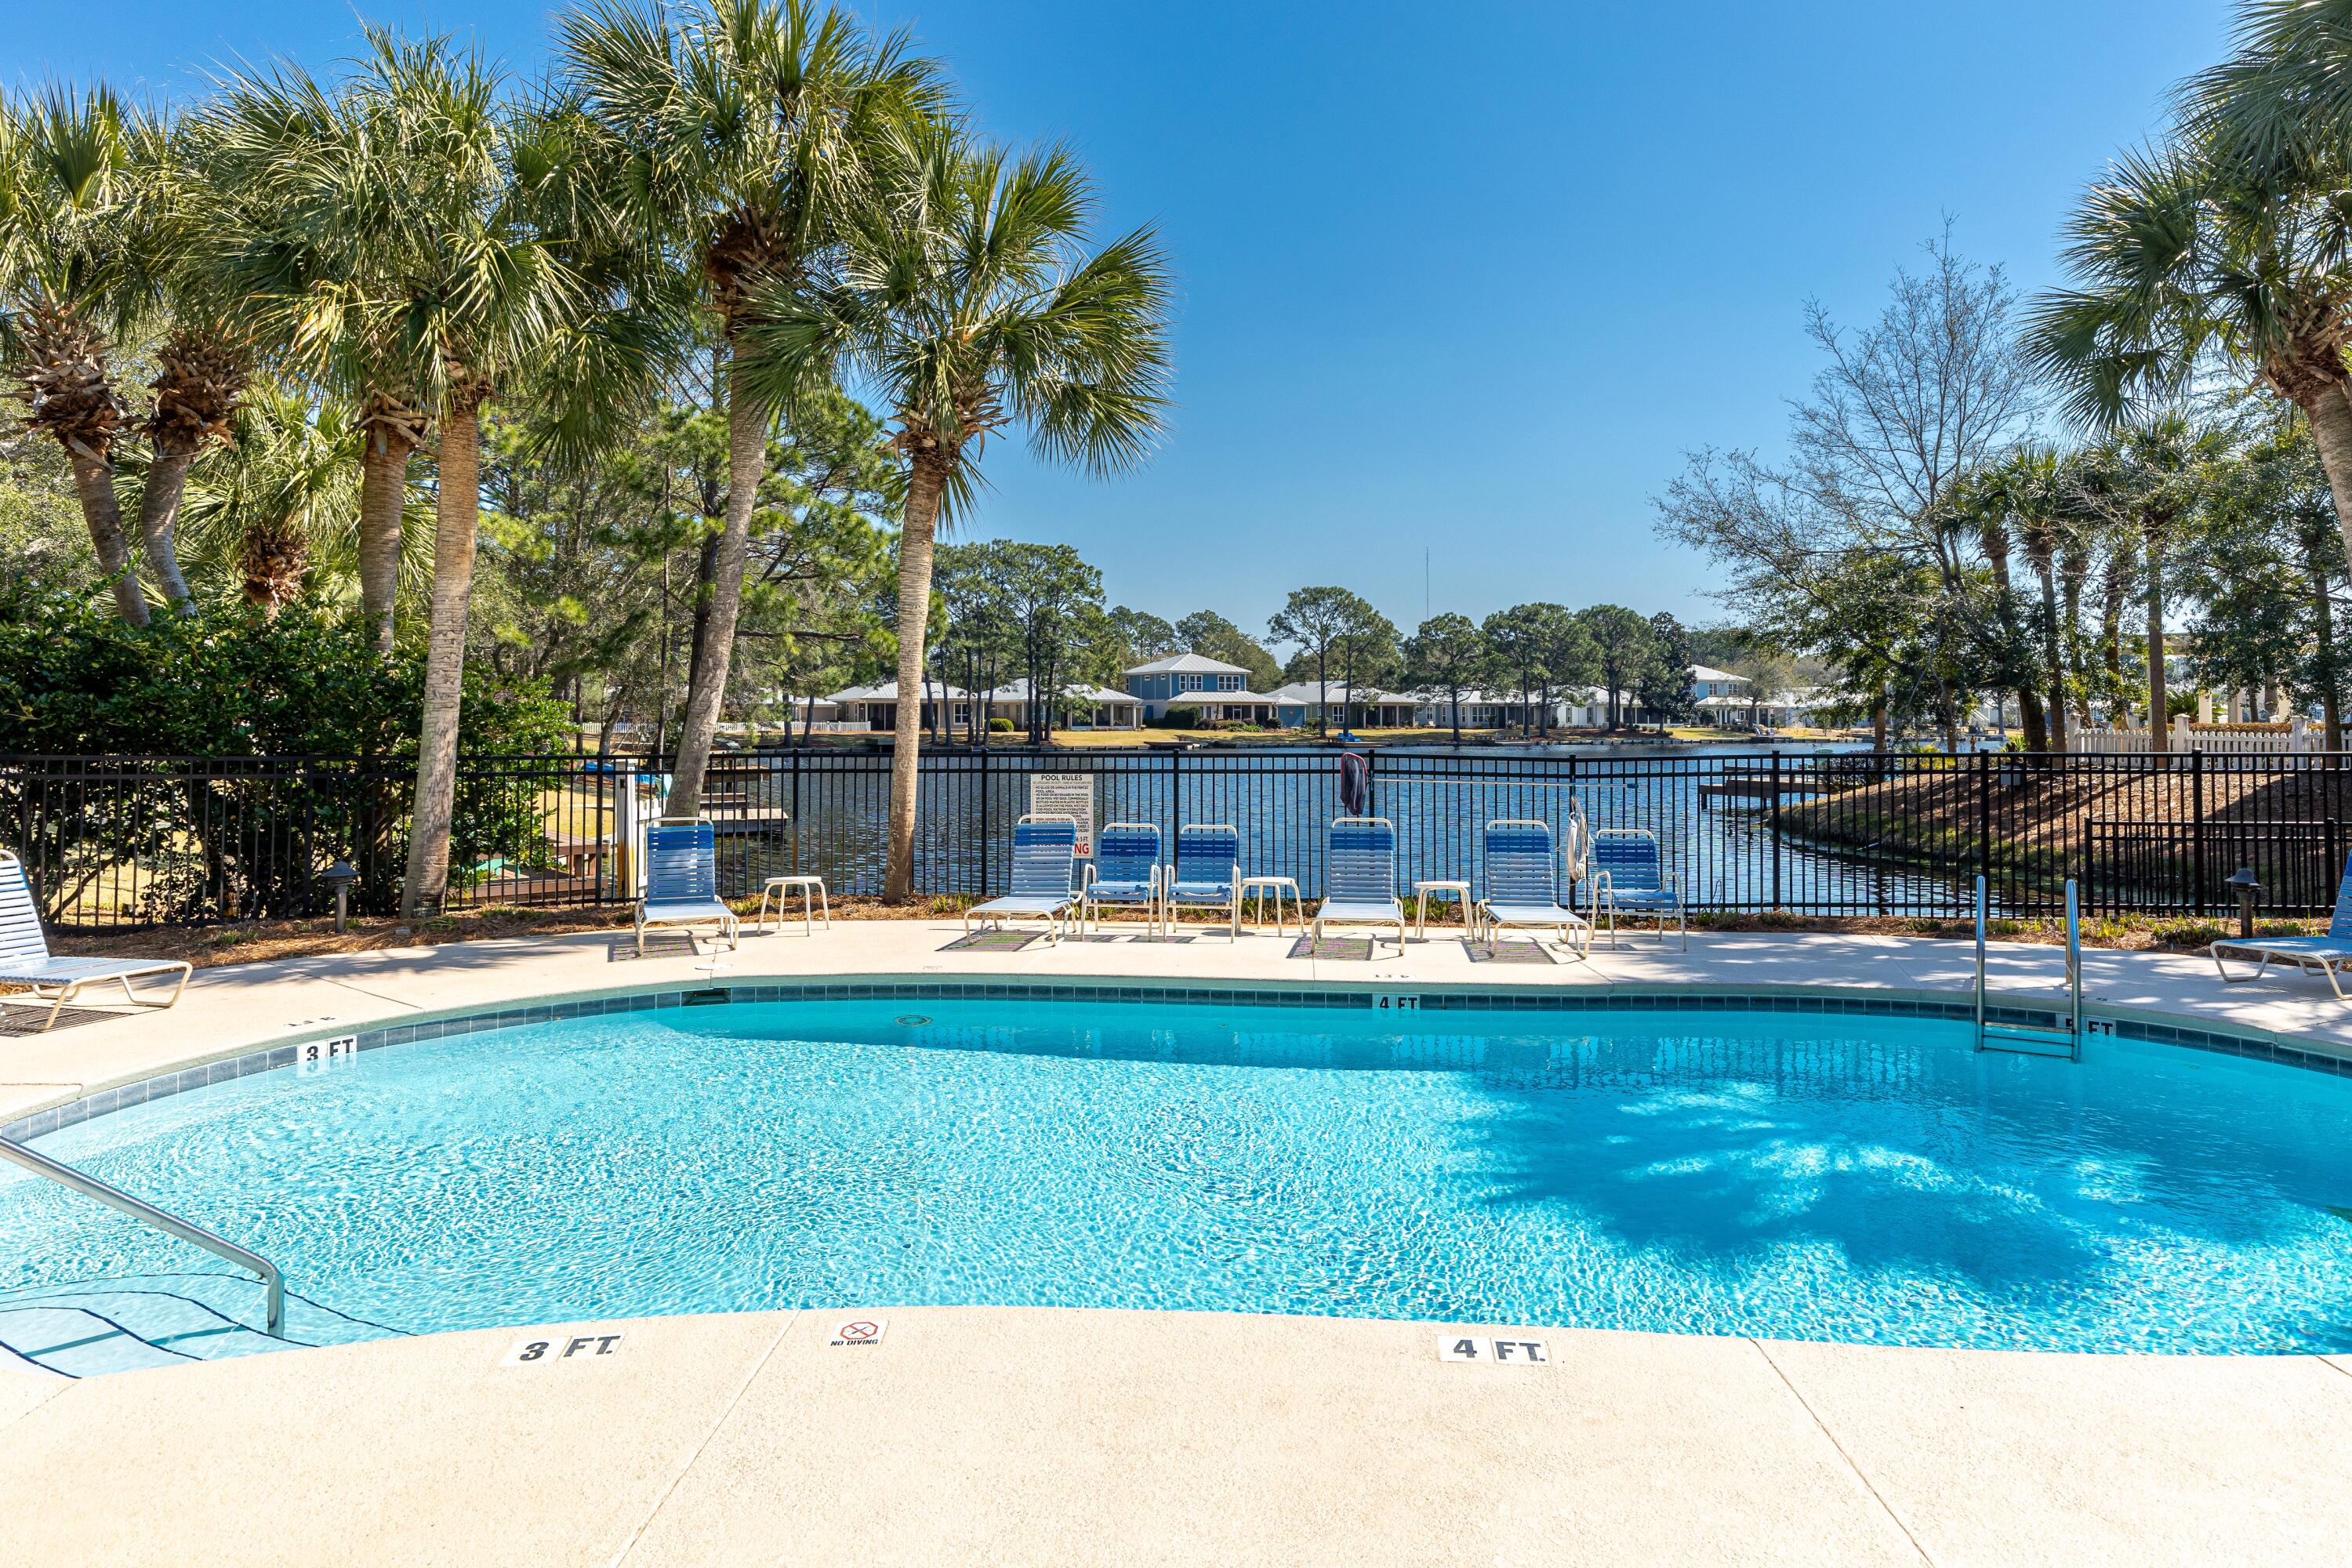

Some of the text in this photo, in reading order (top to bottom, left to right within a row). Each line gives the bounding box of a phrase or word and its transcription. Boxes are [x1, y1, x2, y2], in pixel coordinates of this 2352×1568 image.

[1380, 996, 1389, 1008] 4
[307, 1046, 318, 1062] 3
[519, 1335, 621, 1361] 3 FT.
[1453, 1339, 1546, 1362] 4 FT.
